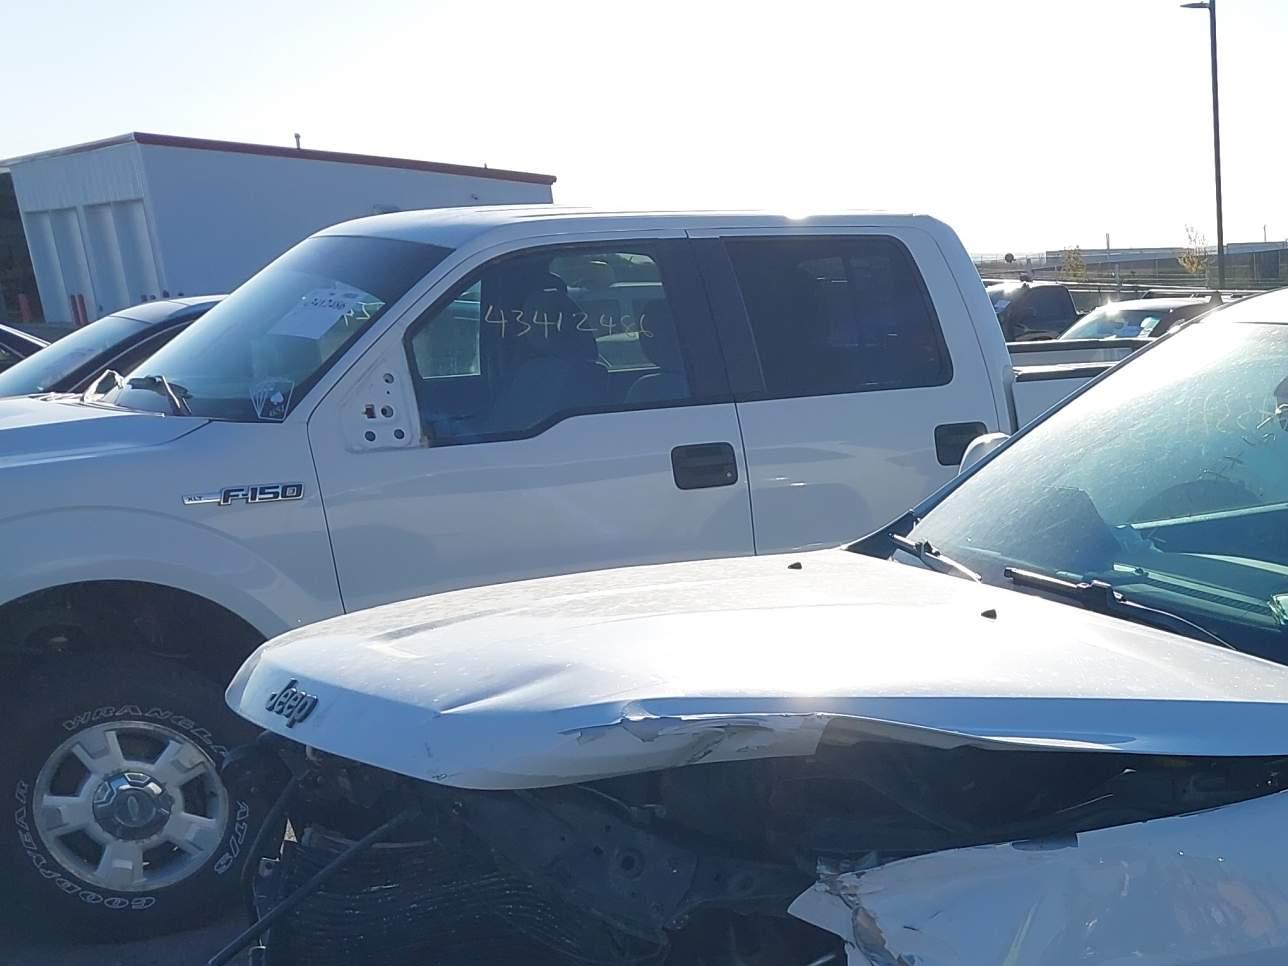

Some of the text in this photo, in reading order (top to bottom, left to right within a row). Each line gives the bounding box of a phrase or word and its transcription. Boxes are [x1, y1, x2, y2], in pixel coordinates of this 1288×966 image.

[484, 304, 654, 339] 43412486
[221, 484, 303, 505] F-150
[265, 678, 319, 728] Jeep
[14, 779, 156, 909] GOODYEAR
